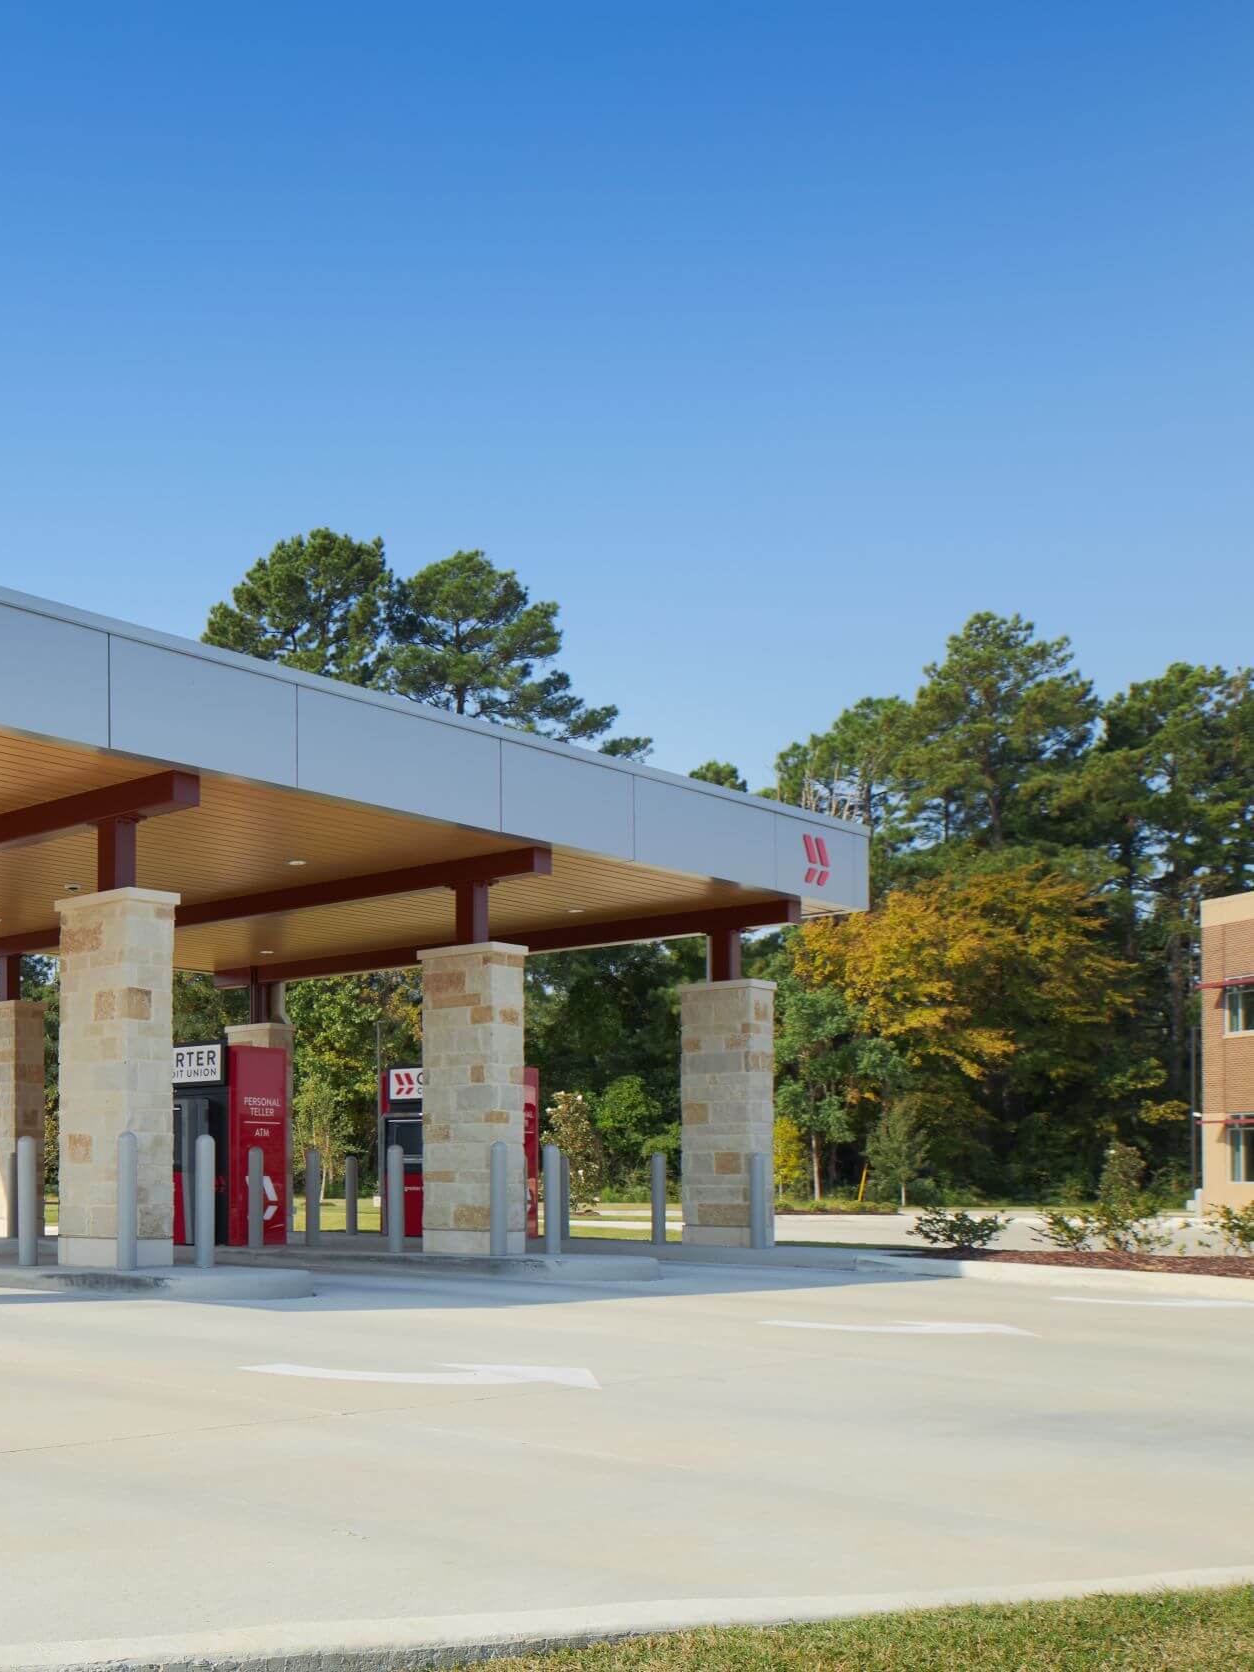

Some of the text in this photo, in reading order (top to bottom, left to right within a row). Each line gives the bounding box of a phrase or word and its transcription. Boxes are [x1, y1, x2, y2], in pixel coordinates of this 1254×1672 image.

[176, 1050, 216, 1068] RTER
[186, 1068, 217, 1077] UNION
[243, 1096, 281, 1106] PERSONAL
[250, 1107, 275, 1117] TELLER
[254, 1128, 270, 1137] ATM
